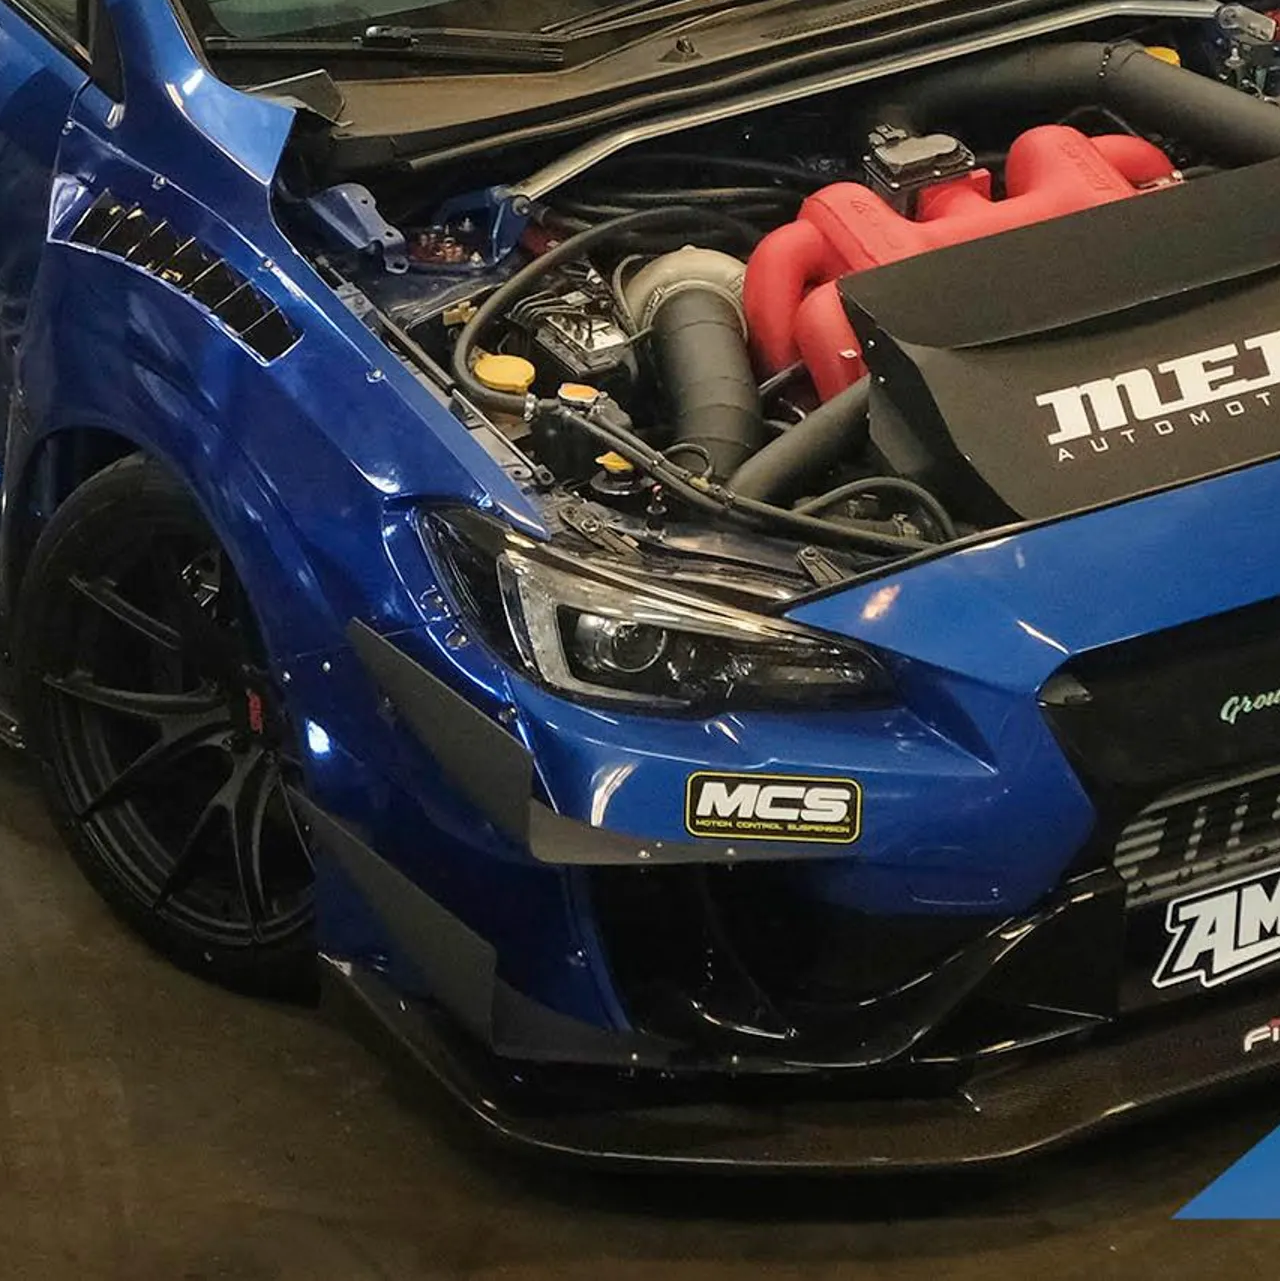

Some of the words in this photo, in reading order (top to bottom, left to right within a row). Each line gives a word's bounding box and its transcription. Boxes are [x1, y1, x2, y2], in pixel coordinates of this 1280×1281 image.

[695, 781, 851, 823] MCS
[695, 819, 733, 829] MOTION
[736, 821, 784, 831] CONTROL
[787, 823, 851, 834] SUSPENSION
